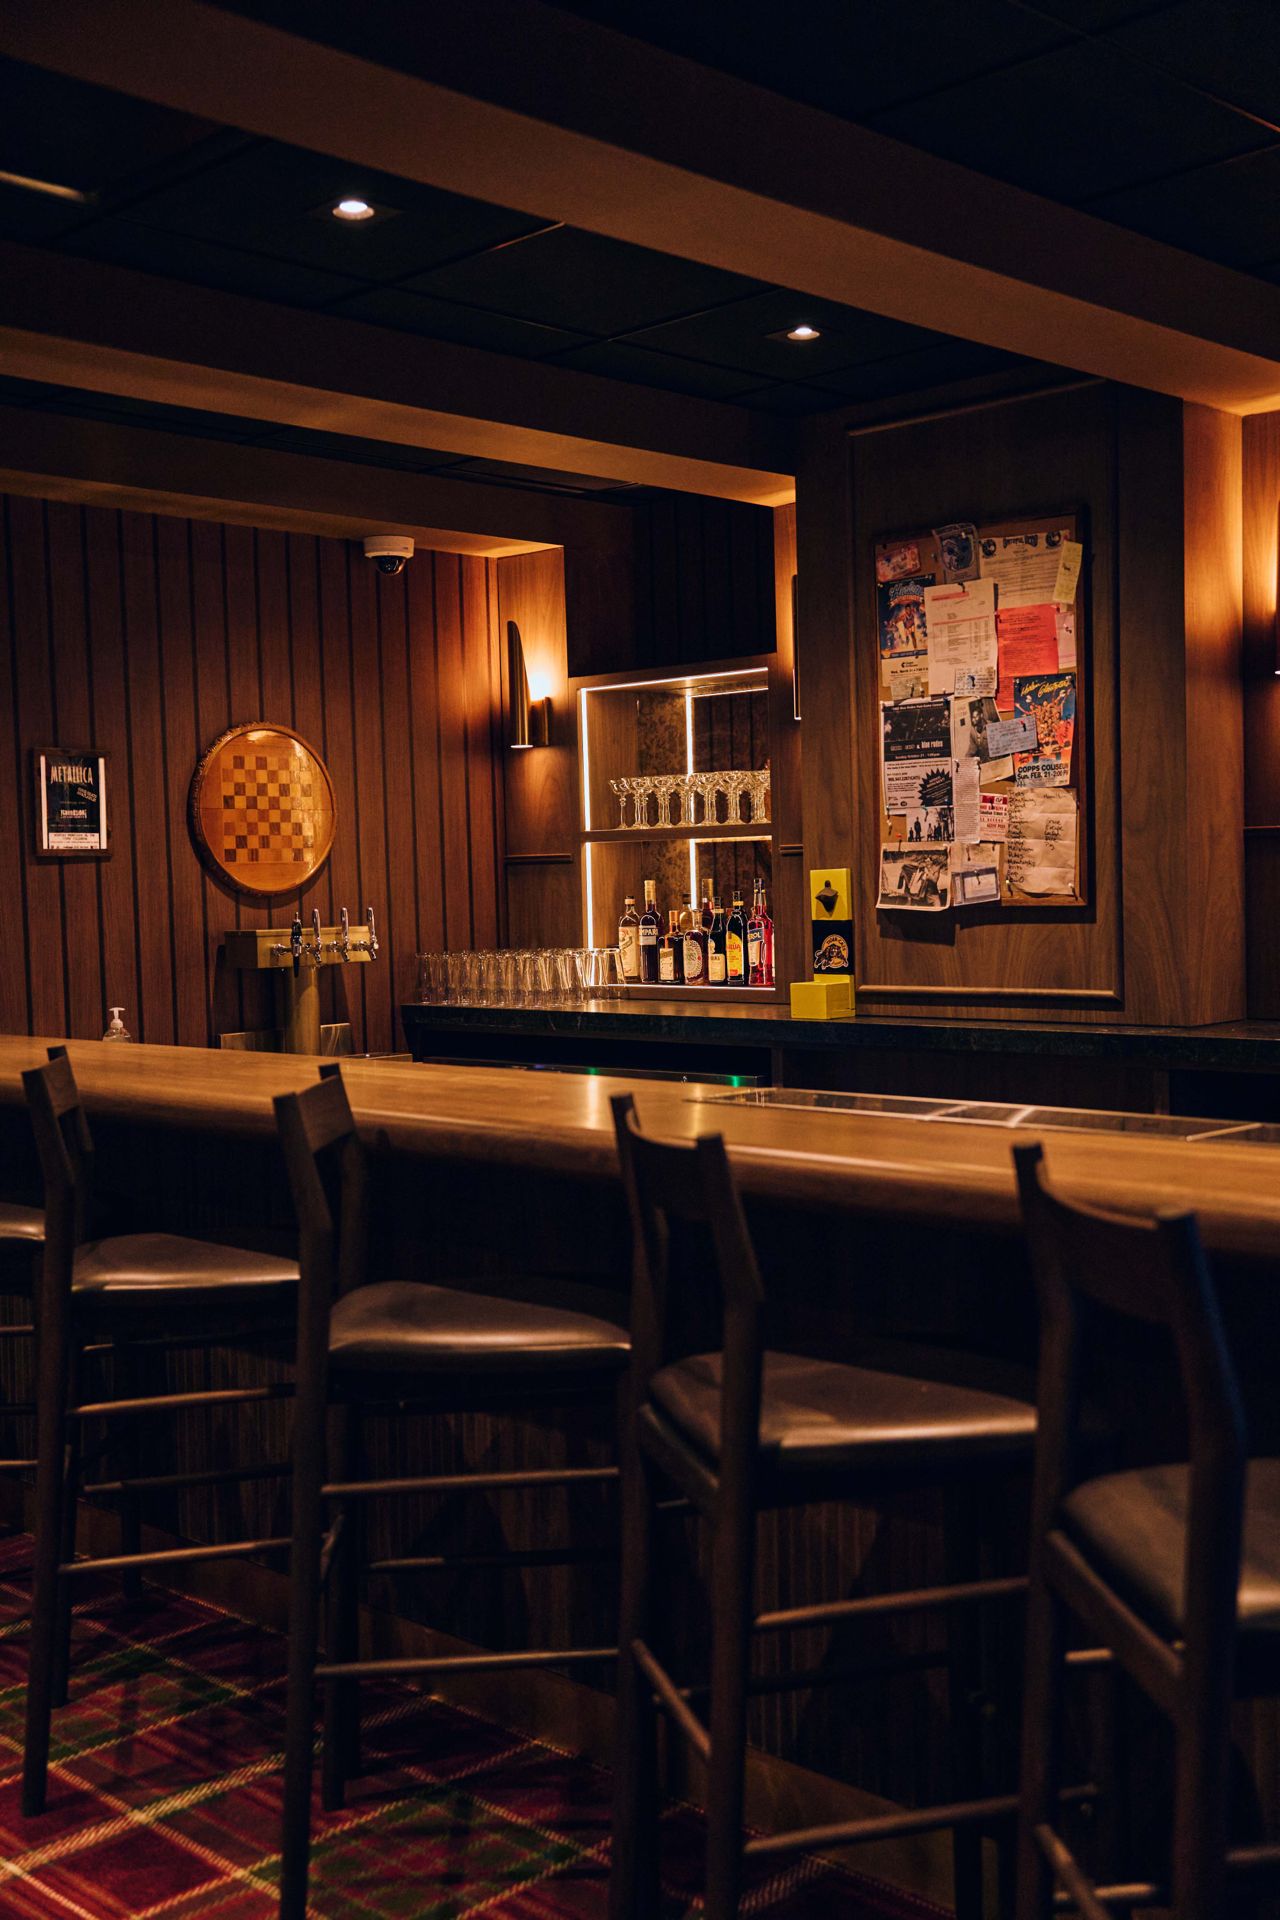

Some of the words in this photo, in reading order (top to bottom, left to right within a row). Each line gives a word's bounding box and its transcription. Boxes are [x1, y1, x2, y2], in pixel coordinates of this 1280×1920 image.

[1018, 765, 1040, 773] COPPS
[50, 765, 93, 786] METALLICA
[639, 928, 658, 936] MPARI
